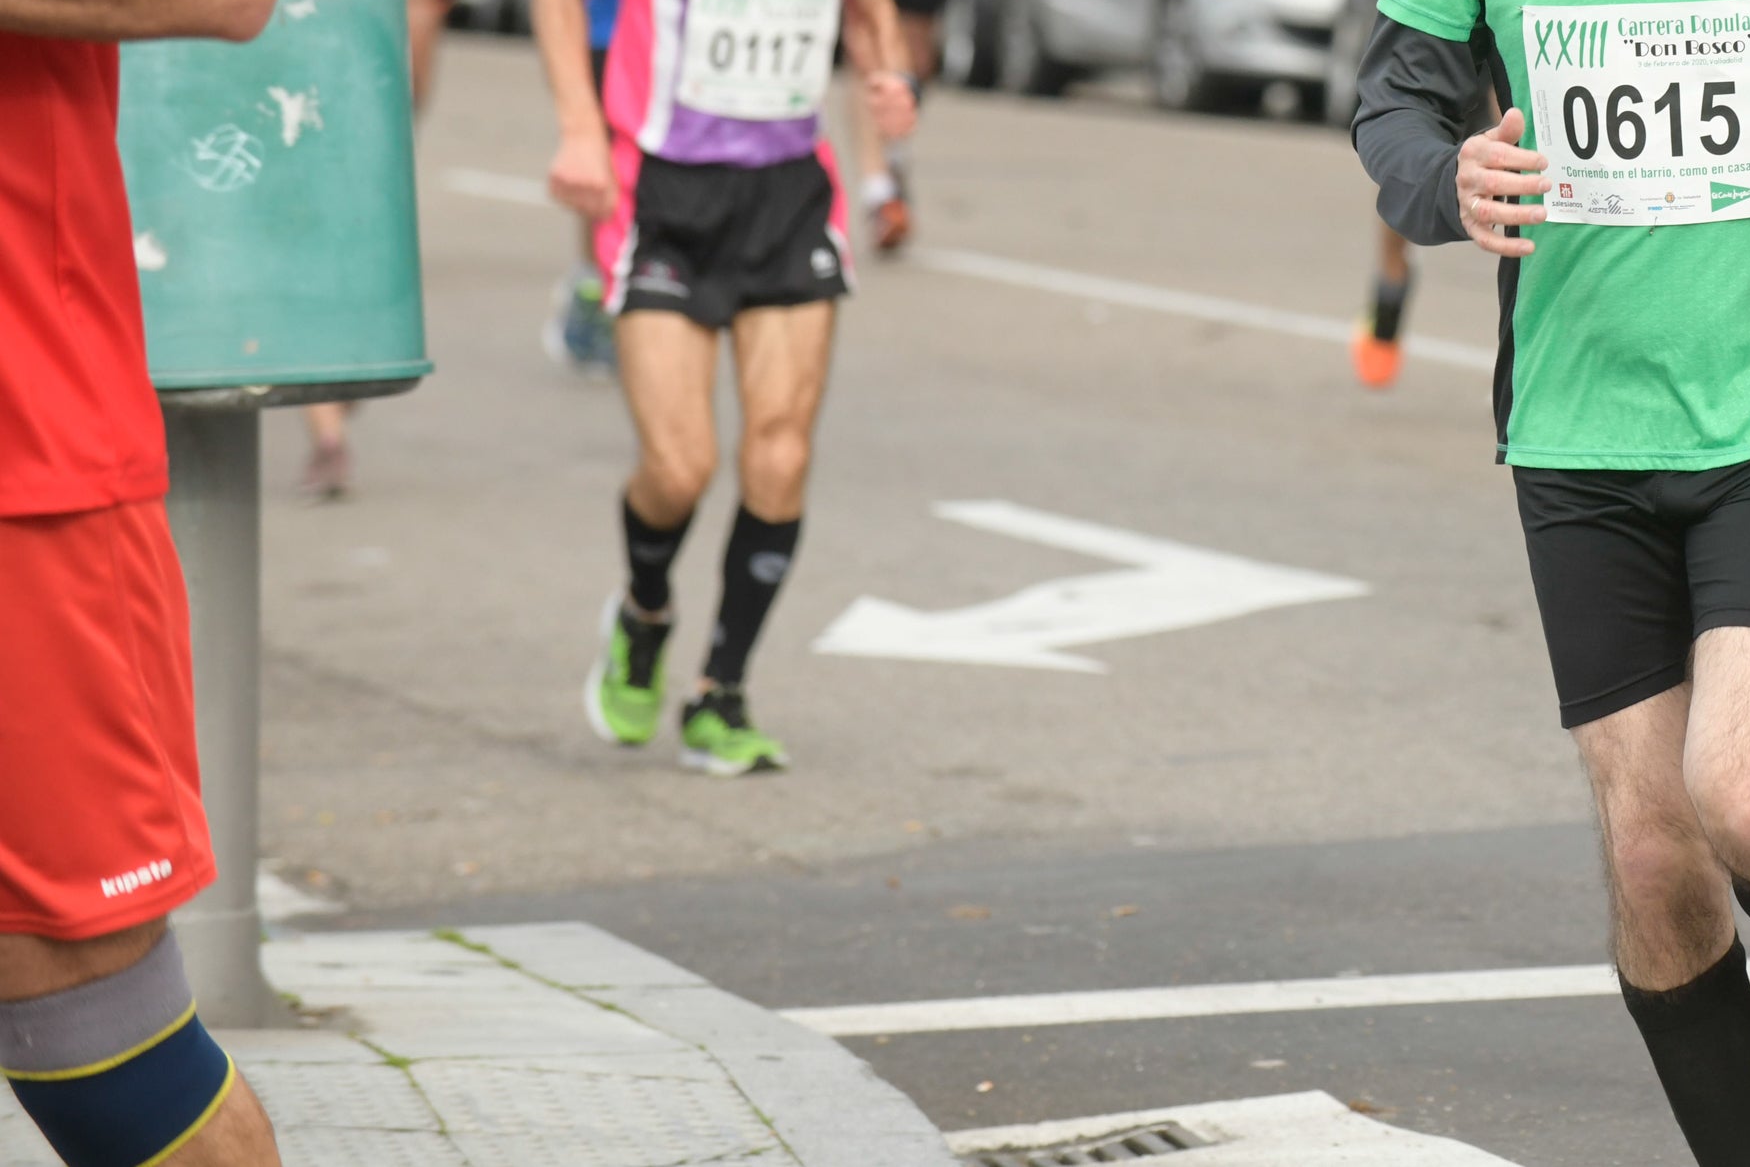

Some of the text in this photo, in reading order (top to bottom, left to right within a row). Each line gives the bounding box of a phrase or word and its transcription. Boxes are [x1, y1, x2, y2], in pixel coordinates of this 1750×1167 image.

[1618, 17, 1684, 36] Carrera
[708, 28, 817, 76] 0117
[1534, 19, 1608, 70] XXIII
[1563, 81, 1741, 161] 0615
[1612, 168, 1624, 179] en
[1628, 166, 1637, 178] el
[1641, 166, 1676, 178] barrio,
[1680, 166, 1708, 176] como
[1712, 165, 1724, 175] en
[1552, 200, 1584, 208] salesianos
